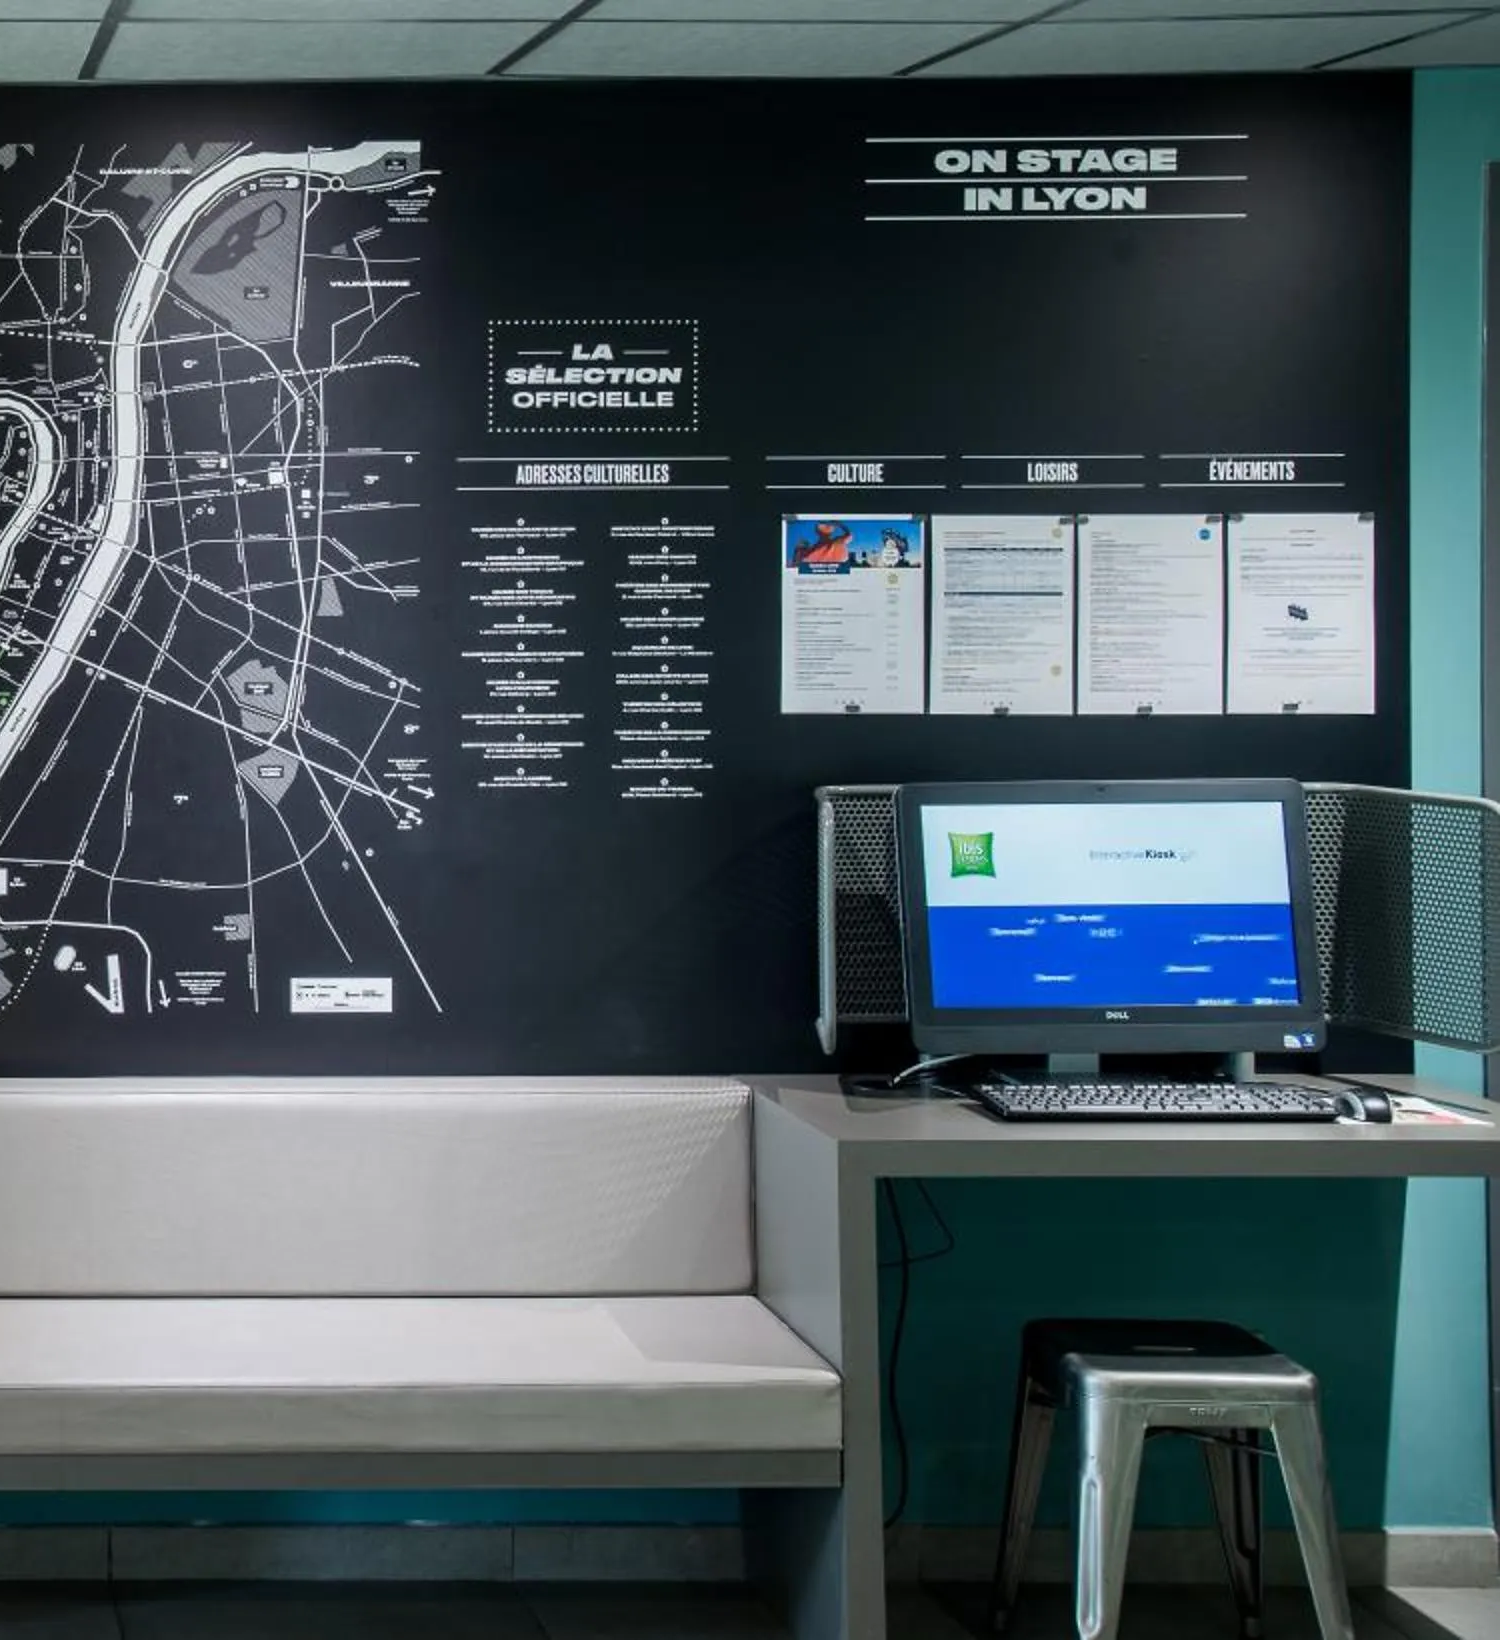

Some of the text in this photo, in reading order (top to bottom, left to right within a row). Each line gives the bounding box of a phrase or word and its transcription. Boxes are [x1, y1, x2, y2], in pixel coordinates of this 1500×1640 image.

[934, 147, 1178, 174] ON STAGE
[963, 186, 1147, 212] IN LYON
[571, 343, 614, 361] LA
[504, 363, 683, 385] SÉLECTION
[512, 391, 674, 409] OFFICIELLE
[515, 463, 670, 485] ADRESSES CULTURELLES
[827, 463, 884, 483] CULTURE
[1027, 462, 1079, 483] LOISIRS
[1209, 459, 1295, 481] ÉVÉNEMENTS
